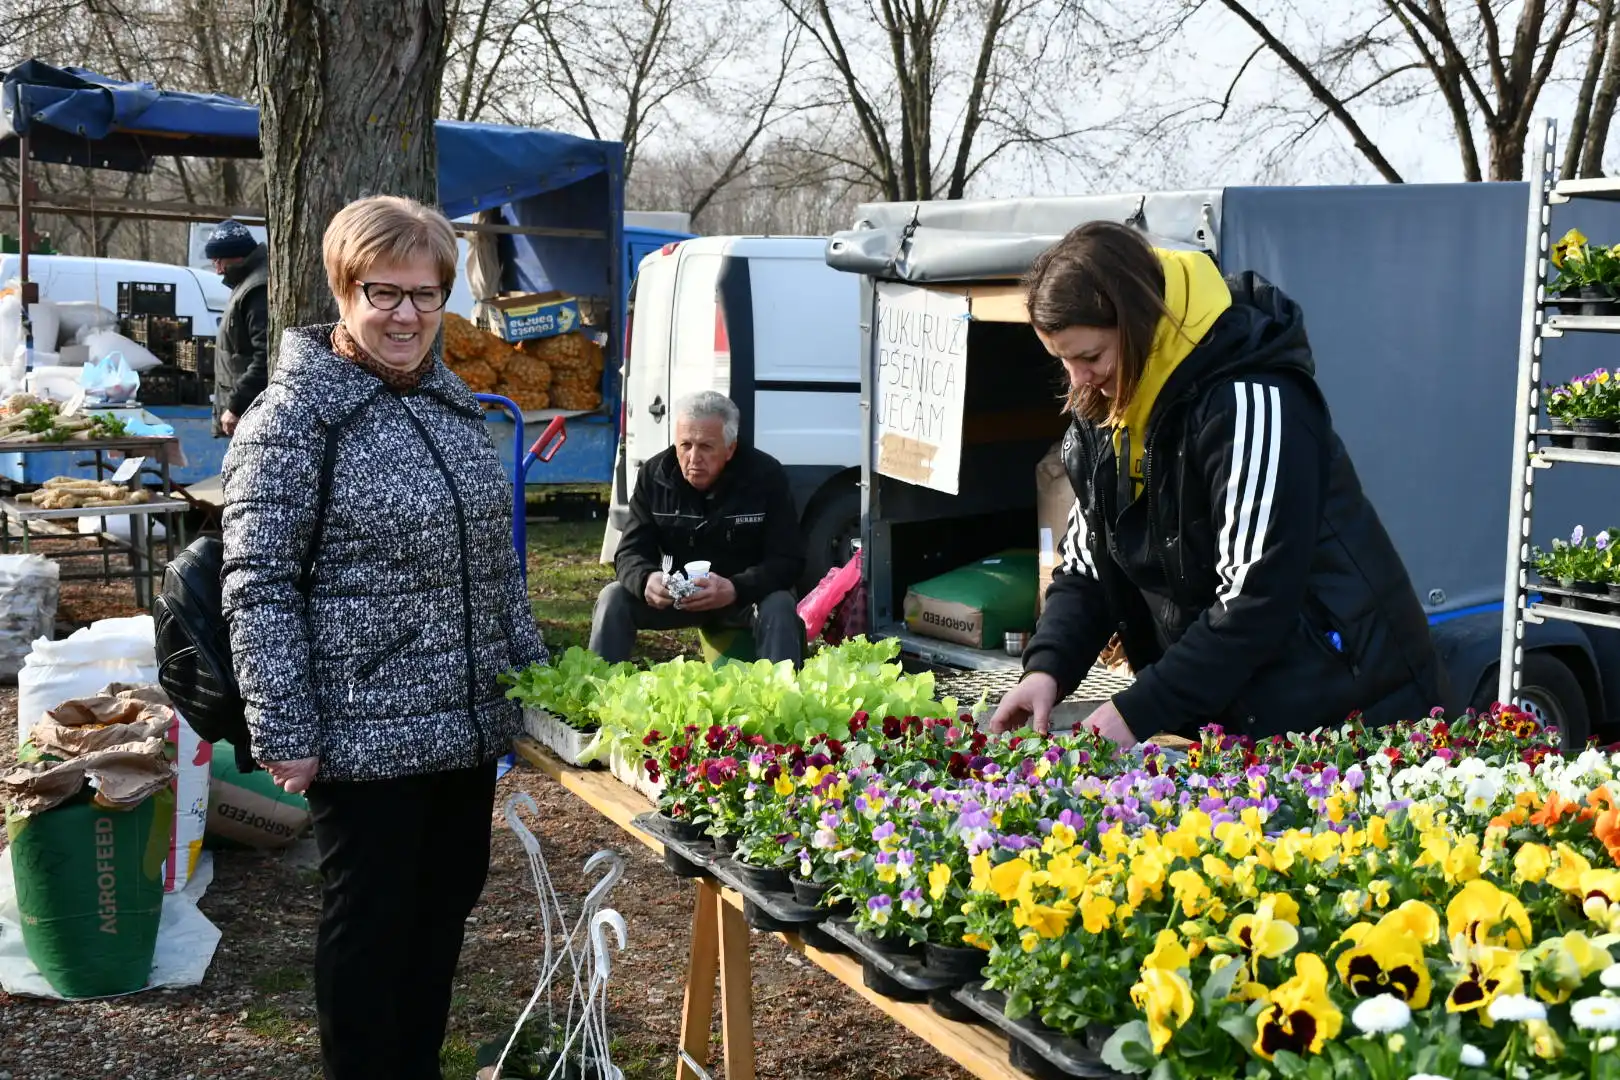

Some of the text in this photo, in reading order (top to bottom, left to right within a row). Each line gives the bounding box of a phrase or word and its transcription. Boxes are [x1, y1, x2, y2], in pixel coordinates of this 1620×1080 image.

[876, 306, 961, 356] KUKURUZ
[877, 348, 956, 397] PŠENICA
[876, 393, 945, 441] JEČAM
[922, 611, 975, 632] AGROFEED
[217, 803, 295, 838] AGROFEED
[95, 817, 118, 935] AGROFEED
